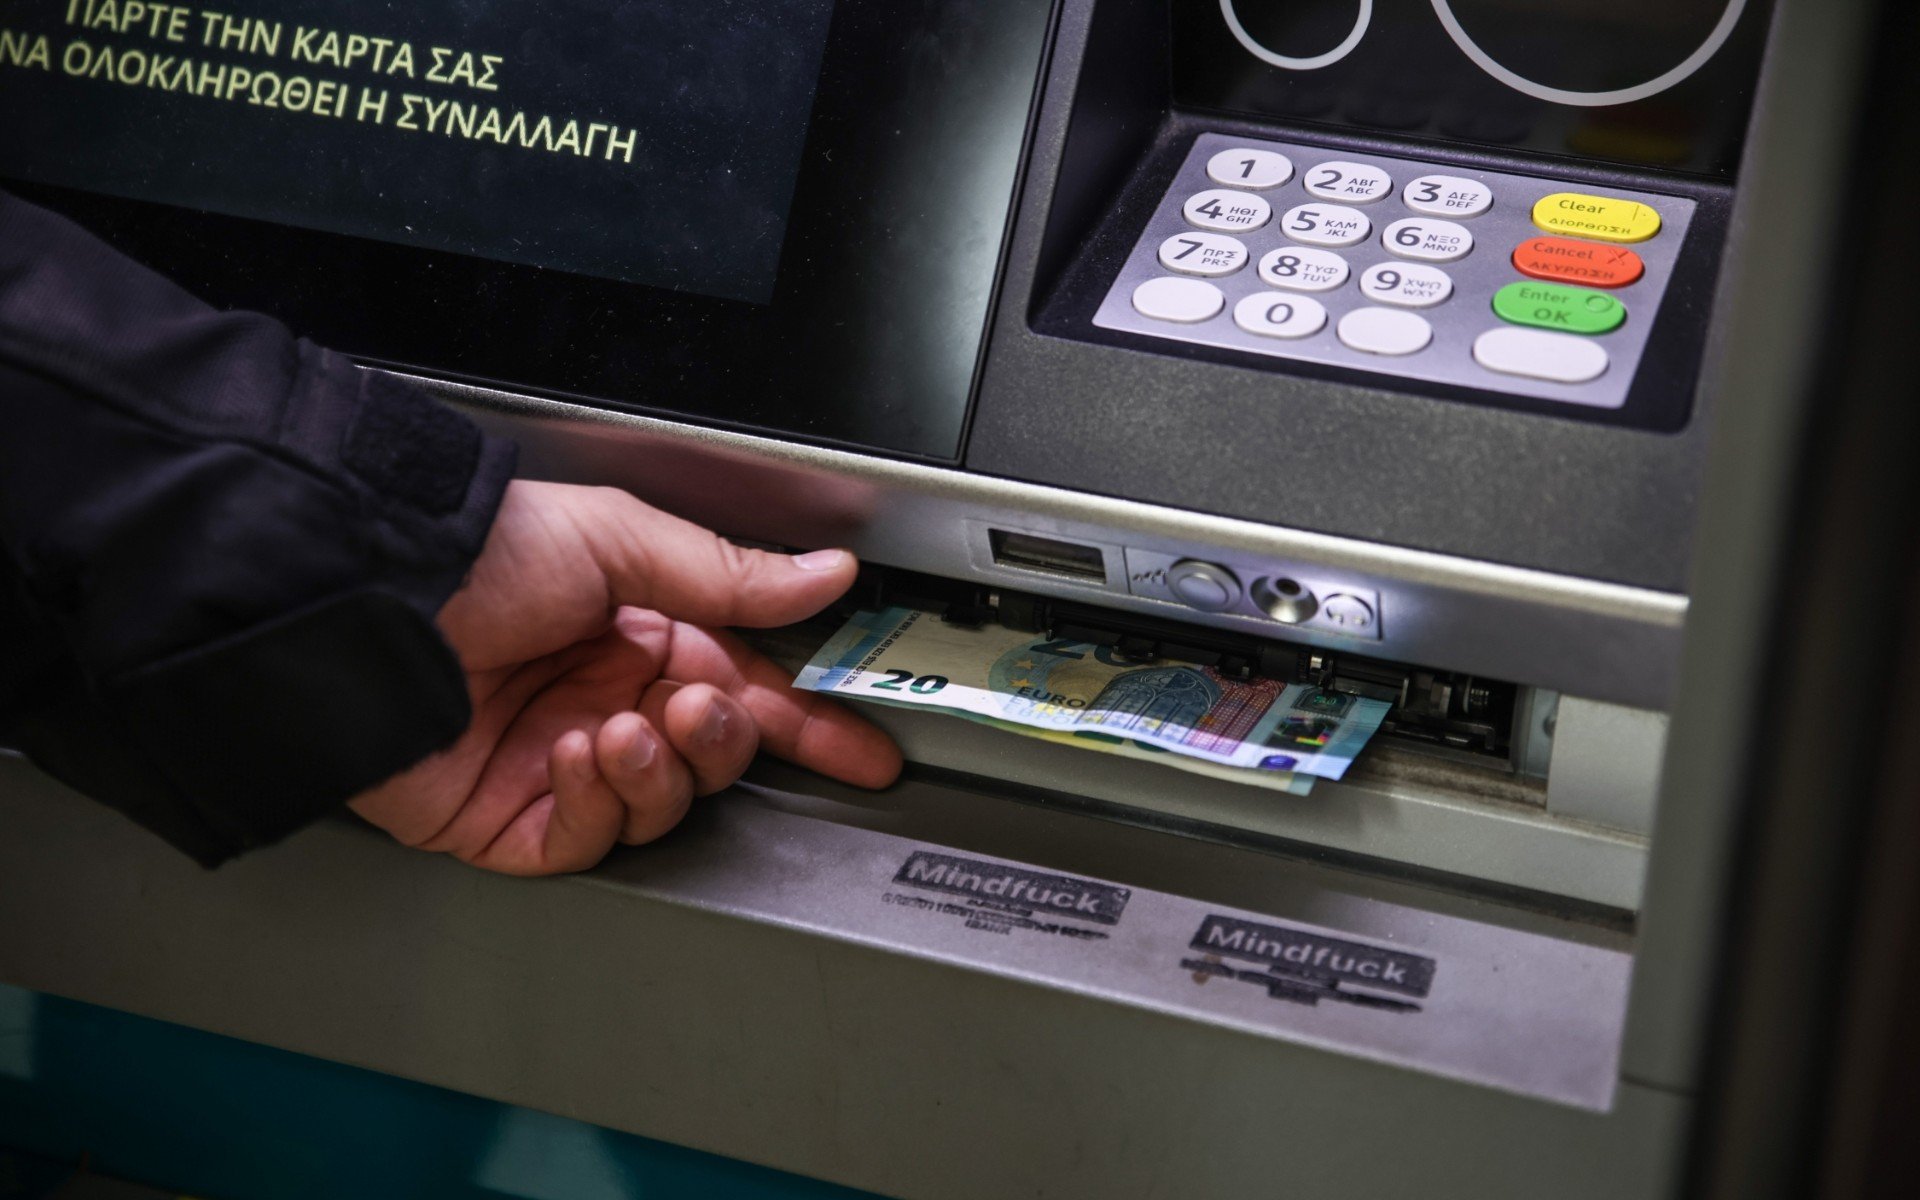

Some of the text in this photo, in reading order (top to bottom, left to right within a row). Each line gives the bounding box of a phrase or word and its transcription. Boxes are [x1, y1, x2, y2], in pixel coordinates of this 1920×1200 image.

[66, 0, 503, 91] ΠΑΡΤΕ ΤΗΝ ΚΑΡΤΑ ΣΑΣ
[0, 30, 637, 163] ΝΑ ΟΛΟΚΛΗΡΩΘΕΙ Η ΣΥΝΑΛΛΑΓΗ
[1240, 159, 1256, 179] 1
[1313, 170, 1343, 190] 2
[1348, 178, 1378, 187] ΑΒΓ
[1344, 186, 1374, 195] ABC
[1413, 181, 1443, 203] 3
[1448, 192, 1479, 201] ΔΕΖ
[1195, 199, 1224, 219] 4
[1229, 207, 1257, 217] ΗΘΙ
[1445, 199, 1474, 209] DEF
[1559, 200, 1606, 214] Clear
[1226, 215, 1253, 225] GHI
[1291, 211, 1320, 231] 5
[1325, 219, 1358, 229] ΚΛΜ
[1324, 228, 1349, 238] JKL
[1395, 226, 1423, 247] 6
[1426, 233, 1460, 244] ΝΞΟ
[1173, 239, 1203, 260] 7
[1202, 248, 1239, 259] ΠΡΣ
[1422, 242, 1458, 252] MNO
[1533, 242, 1594, 260] Cancel
[1201, 257, 1229, 267] PRS
[1270, 255, 1301, 277] 8
[1304, 264, 1339, 275] ΤΥΦ
[1302, 273, 1332, 283] TUV
[1373, 270, 1401, 291] 9
[1519, 287, 1570, 304] Enter
[1265, 303, 1294, 324] 0
[1533, 308, 1571, 323] OK
[870, 669, 949, 694] 20
[1017, 686, 1086, 708] EURO
[907, 858, 1101, 913] Mindfuck
[1207, 925, 1408, 984] Mindfuck
